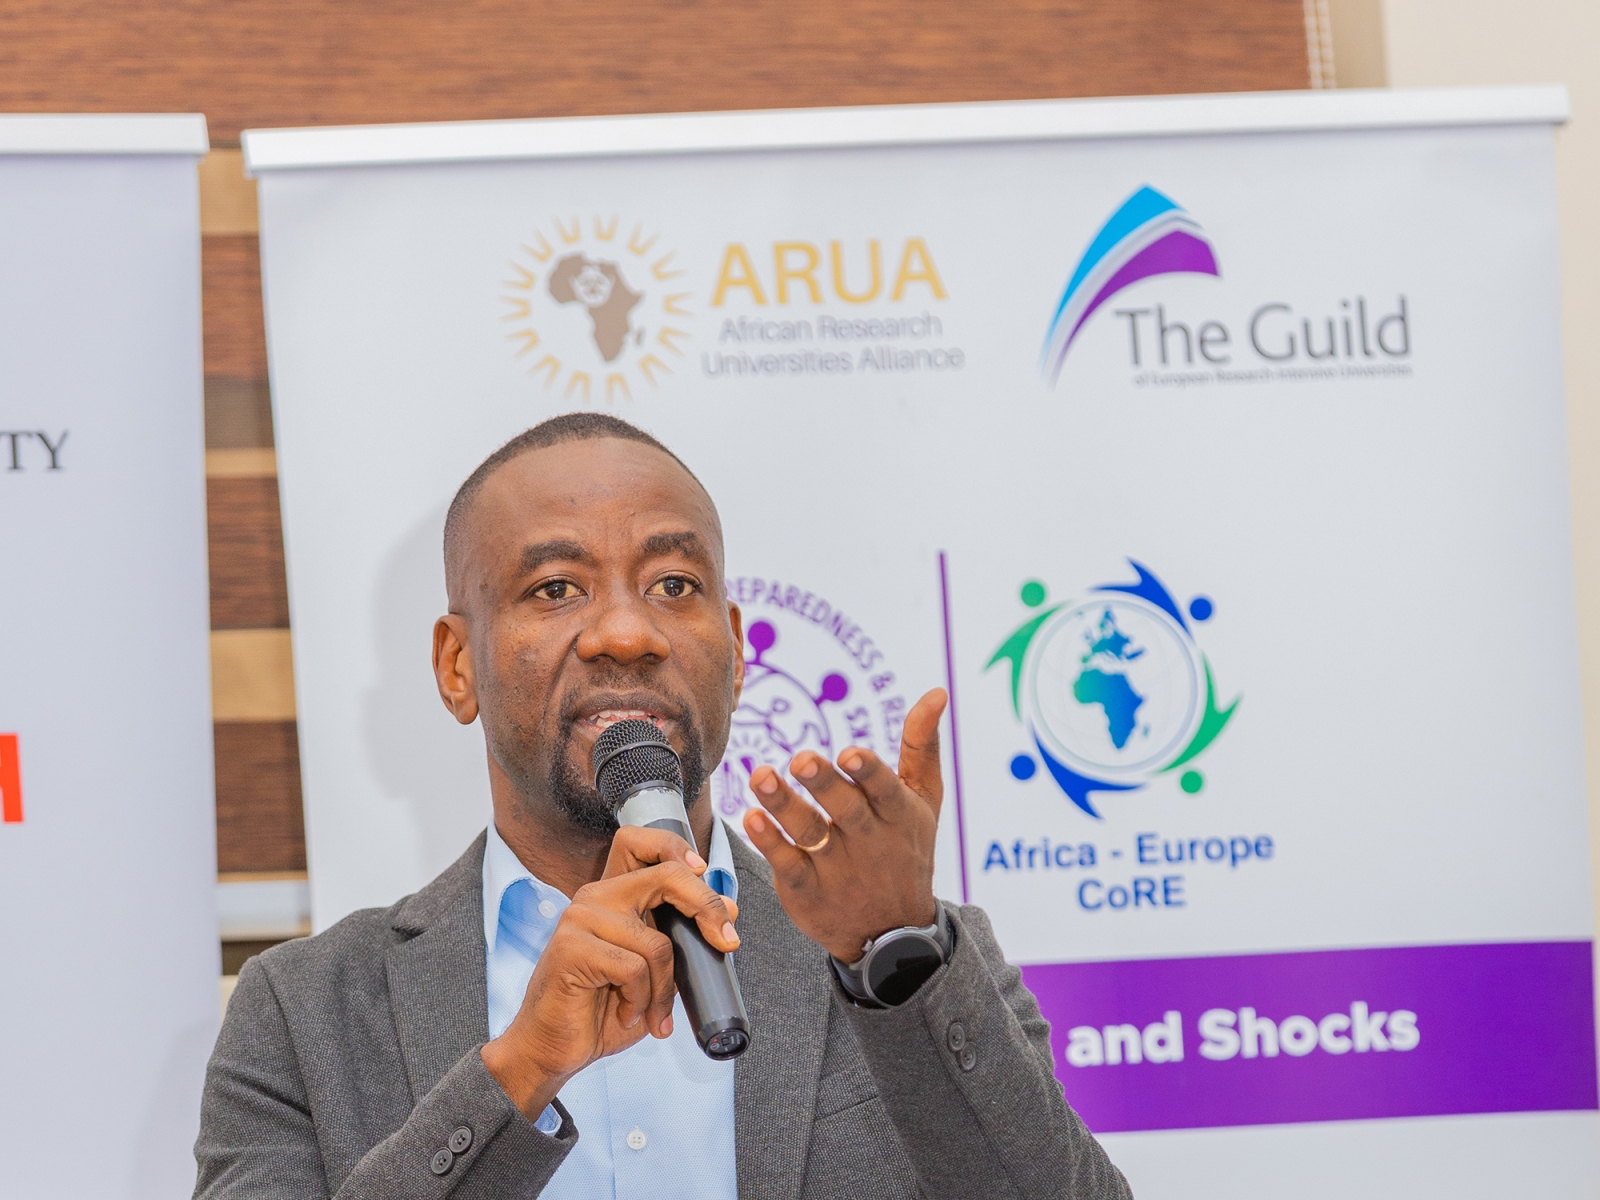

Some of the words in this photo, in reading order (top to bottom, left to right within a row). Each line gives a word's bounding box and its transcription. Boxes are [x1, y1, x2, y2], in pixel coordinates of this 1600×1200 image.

[711, 238, 949, 308] ARUA
[718, 316, 814, 346] African
[817, 311, 943, 341] Research
[1114, 303, 1232, 368] The
[1249, 295, 1413, 364] Guild
[703, 350, 853, 379] Universities
[858, 346, 967, 374] Alliance
[0, 429, 69, 472] TY
[983, 838, 1099, 873] Africa
[1136, 832, 1275, 869] Europe
[1078, 876, 1185, 912] CoRE
[1066, 1011, 1184, 1067] and
[1199, 1001, 1421, 1061] Shocks
